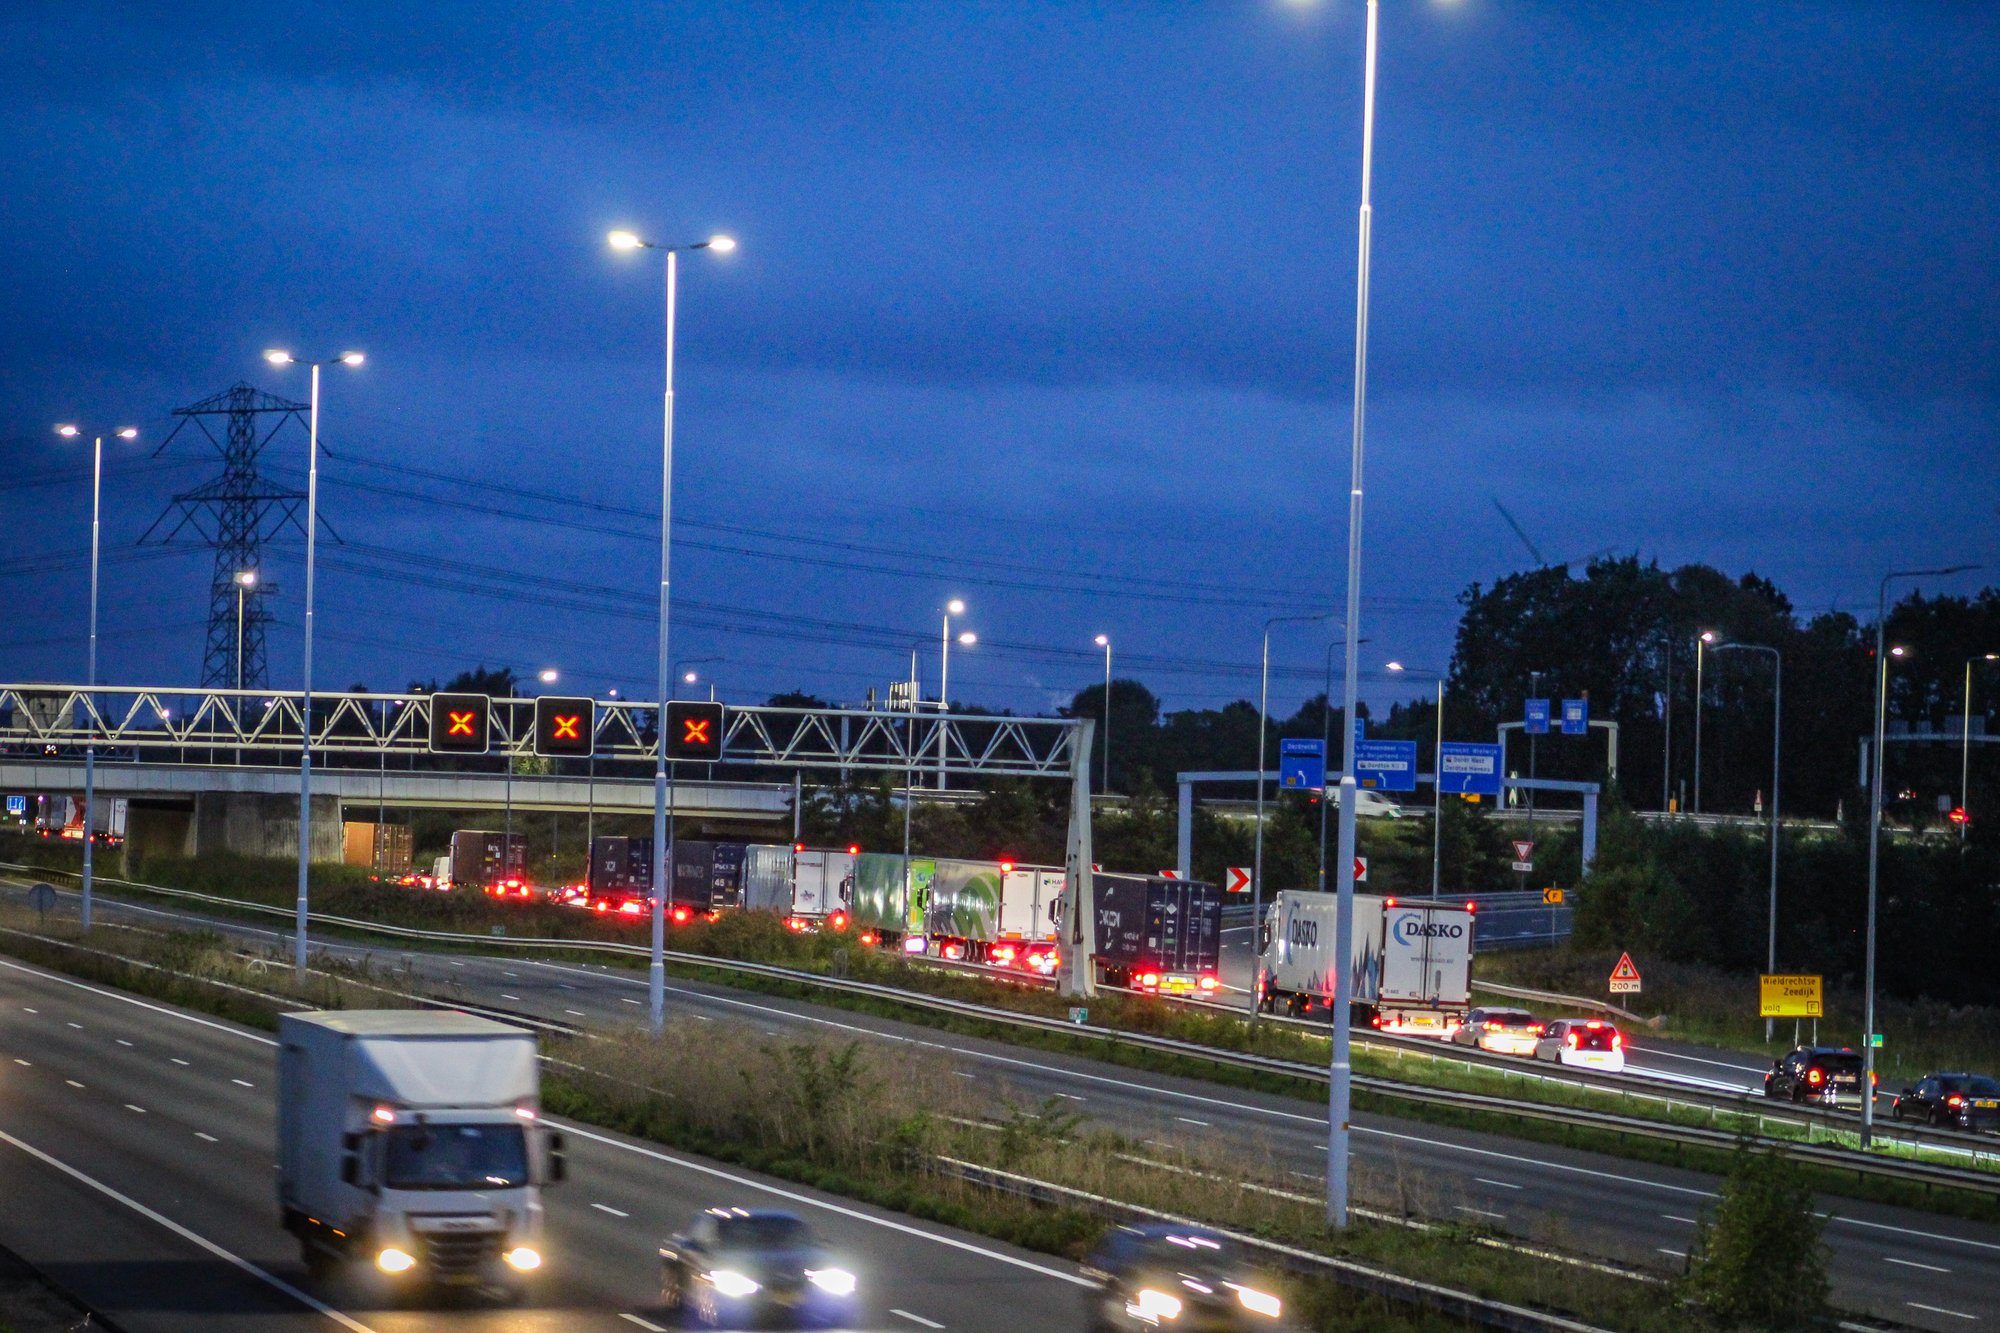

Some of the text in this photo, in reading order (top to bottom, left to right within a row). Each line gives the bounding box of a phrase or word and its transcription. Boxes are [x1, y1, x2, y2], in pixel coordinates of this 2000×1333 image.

[1291, 918, 1318, 948] DASKO
[1405, 922, 1463, 939] DASKO
[1611, 982, 1629, 990] 200
[1763, 977, 1817, 986] Wieldrechtse
[1783, 987, 1815, 998] Zeedijk
[1763, 1003, 1817, 1013] volg F
